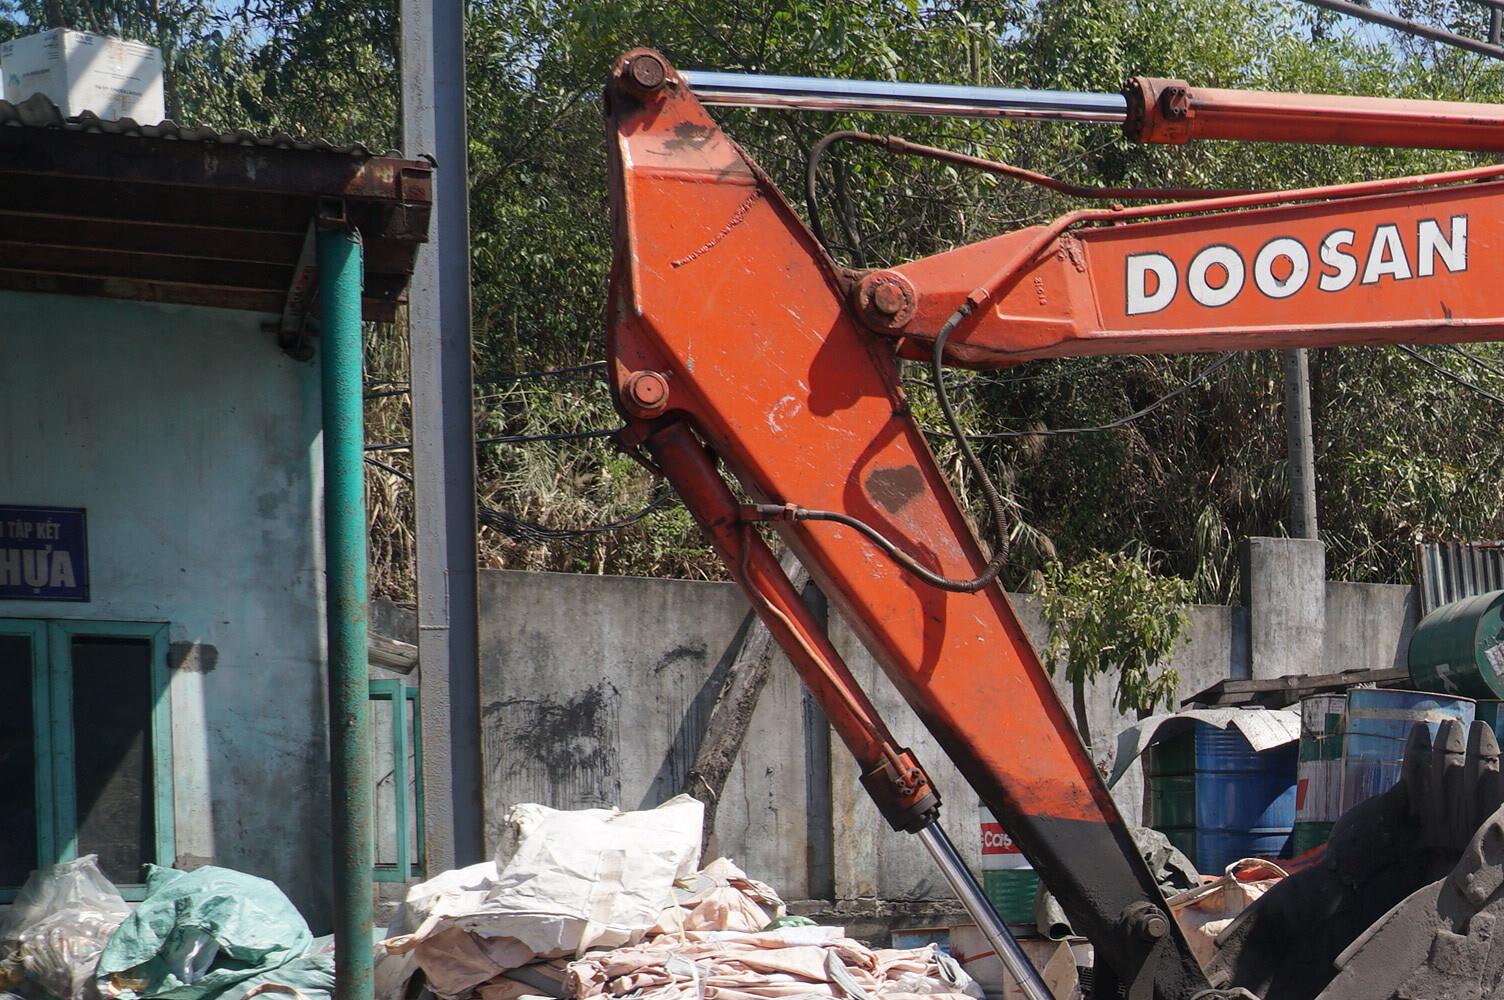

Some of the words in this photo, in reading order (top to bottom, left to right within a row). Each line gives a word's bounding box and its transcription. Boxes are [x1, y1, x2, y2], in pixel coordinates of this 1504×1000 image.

[1126, 213, 1469, 316] DOOSAN
[37, 517, 61, 540] KẾT
[0, 544, 77, 594] HỰA
